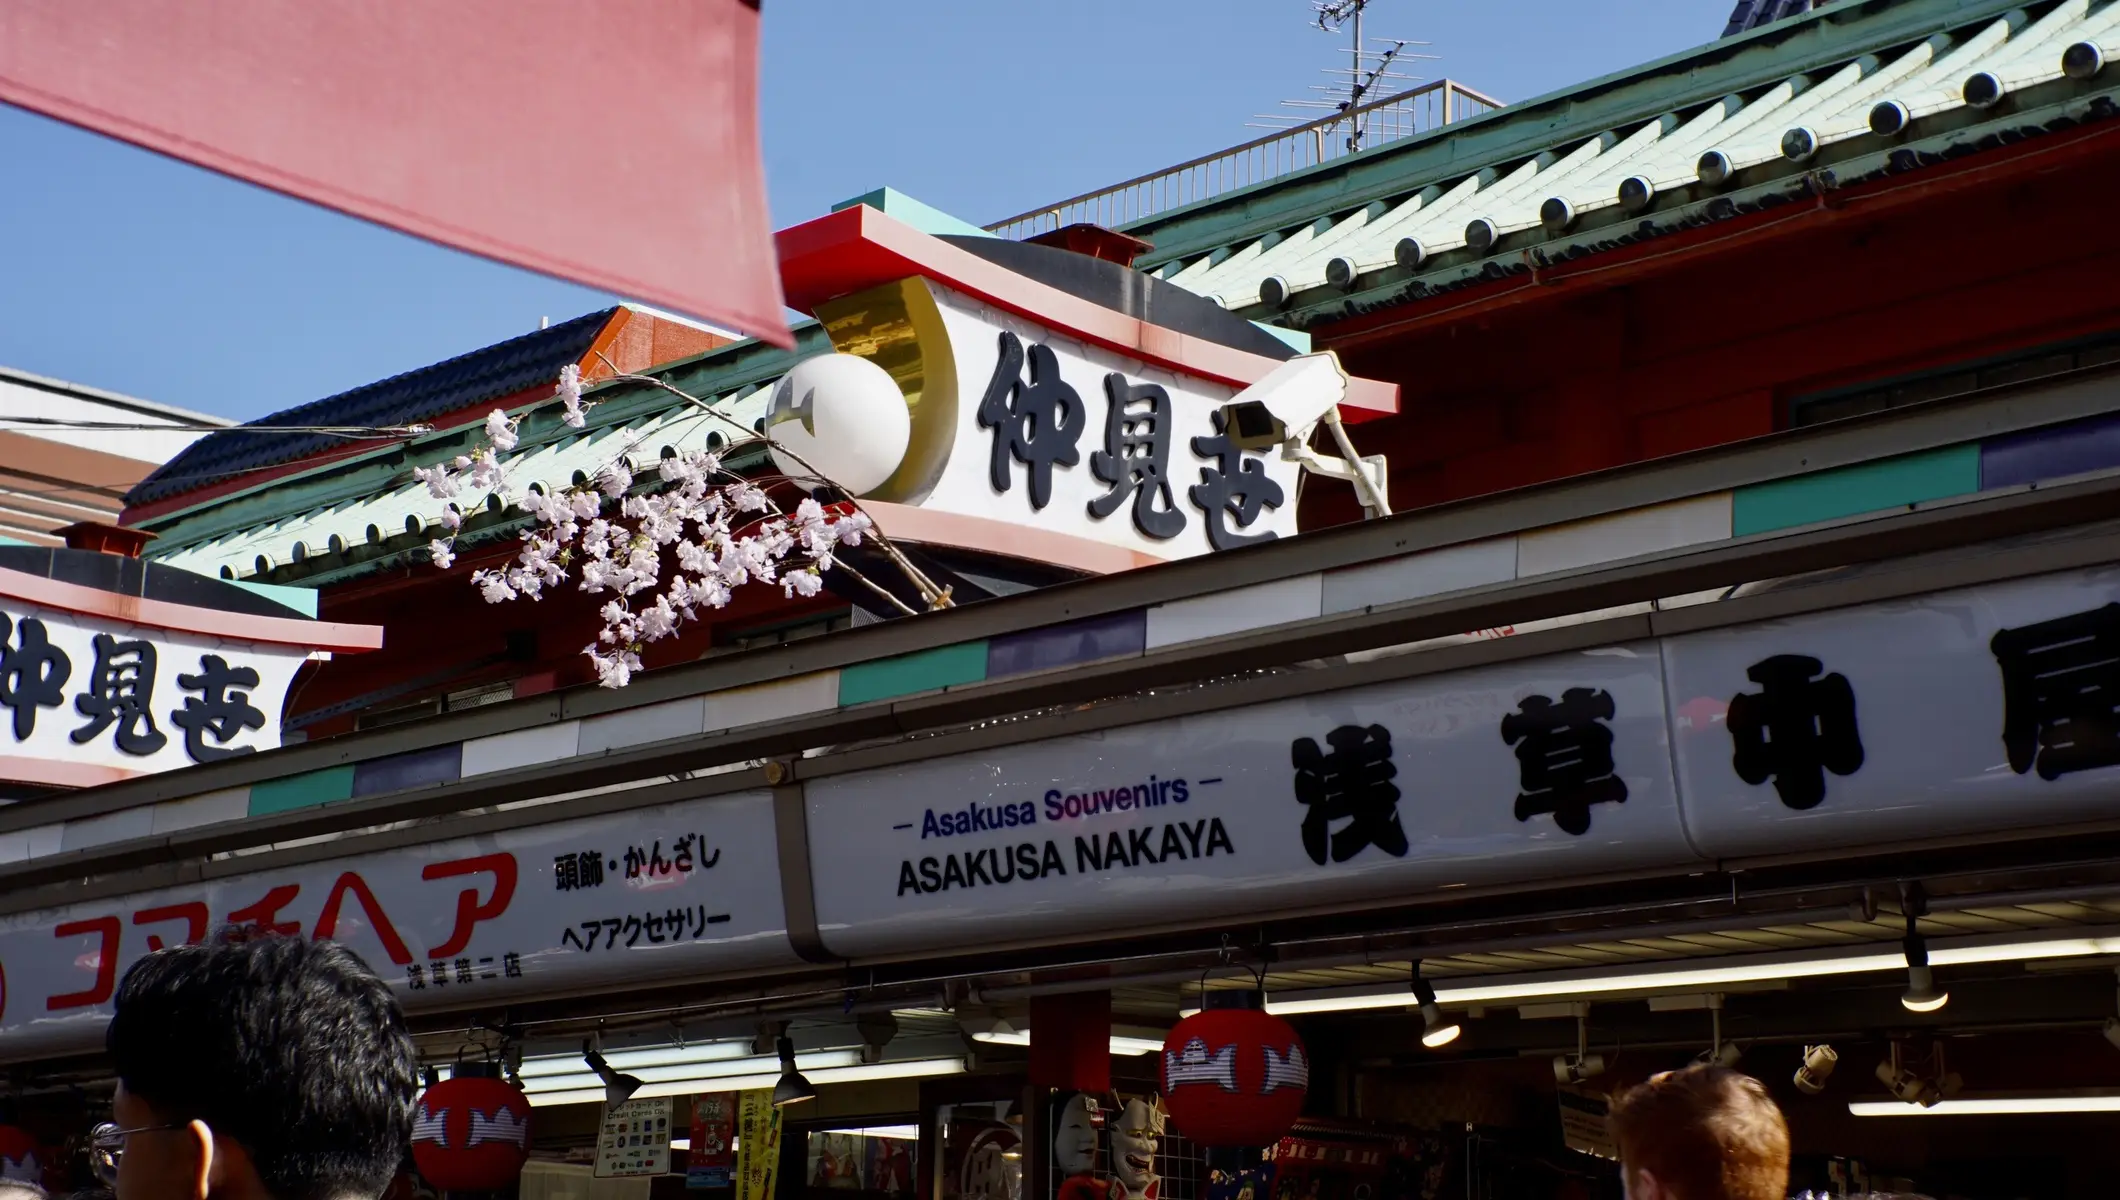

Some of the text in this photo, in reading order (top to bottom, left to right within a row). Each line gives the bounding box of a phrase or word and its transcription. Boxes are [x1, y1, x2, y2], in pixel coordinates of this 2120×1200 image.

[977, 330, 1285, 551] 仲見世
[920, 774, 1190, 839] Asakusa Souvenirs
[553, 832, 721, 892] 頭飾・かんざし
[896, 817, 1235, 896] ASAKUSA NAKAYA
[561, 904, 732, 952] ヘアアクセサリー
